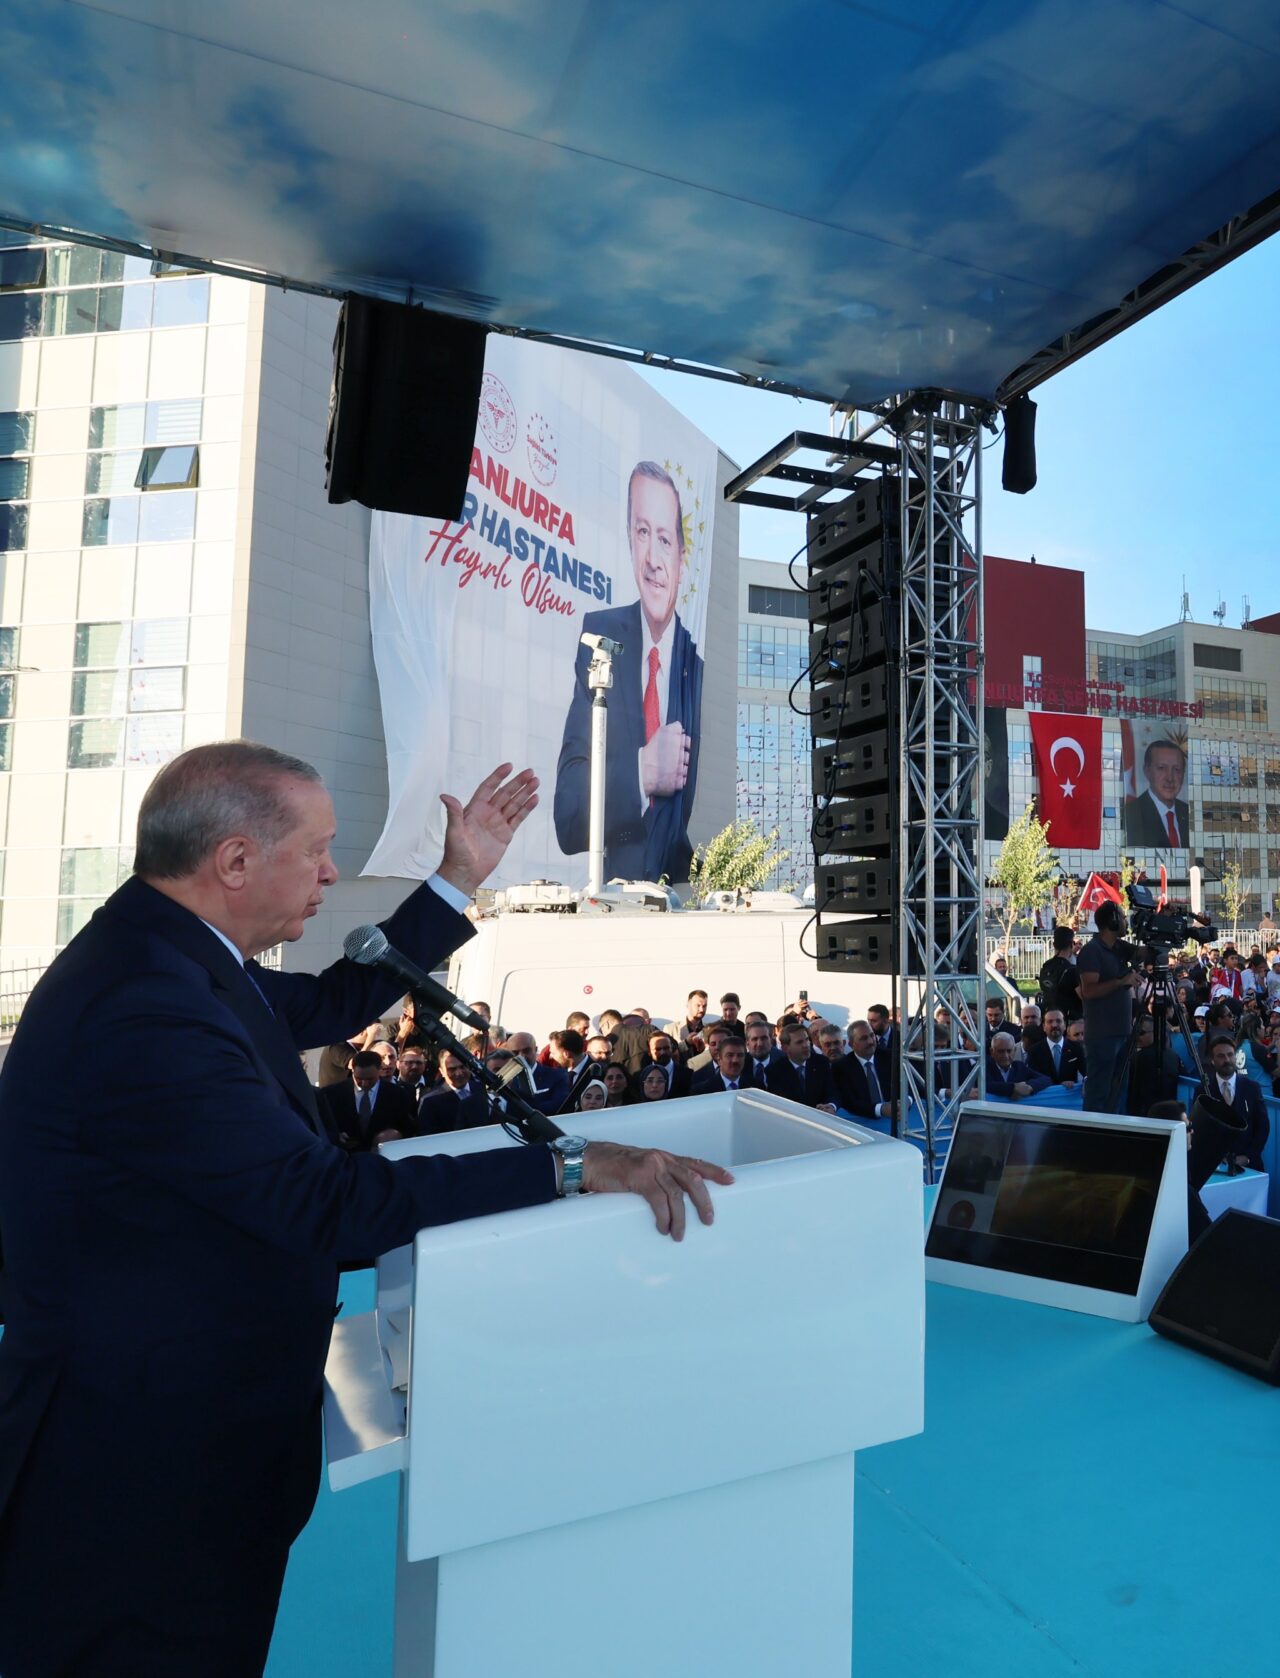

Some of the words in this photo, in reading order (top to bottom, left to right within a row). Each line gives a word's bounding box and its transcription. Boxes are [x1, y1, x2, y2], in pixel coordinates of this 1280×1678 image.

[470, 446, 575, 546] ANLIURFA
[425, 519, 512, 590] Hayırlı
[521, 562, 575, 616] Olsun
[479, 503, 612, 605] HASTANESİ
